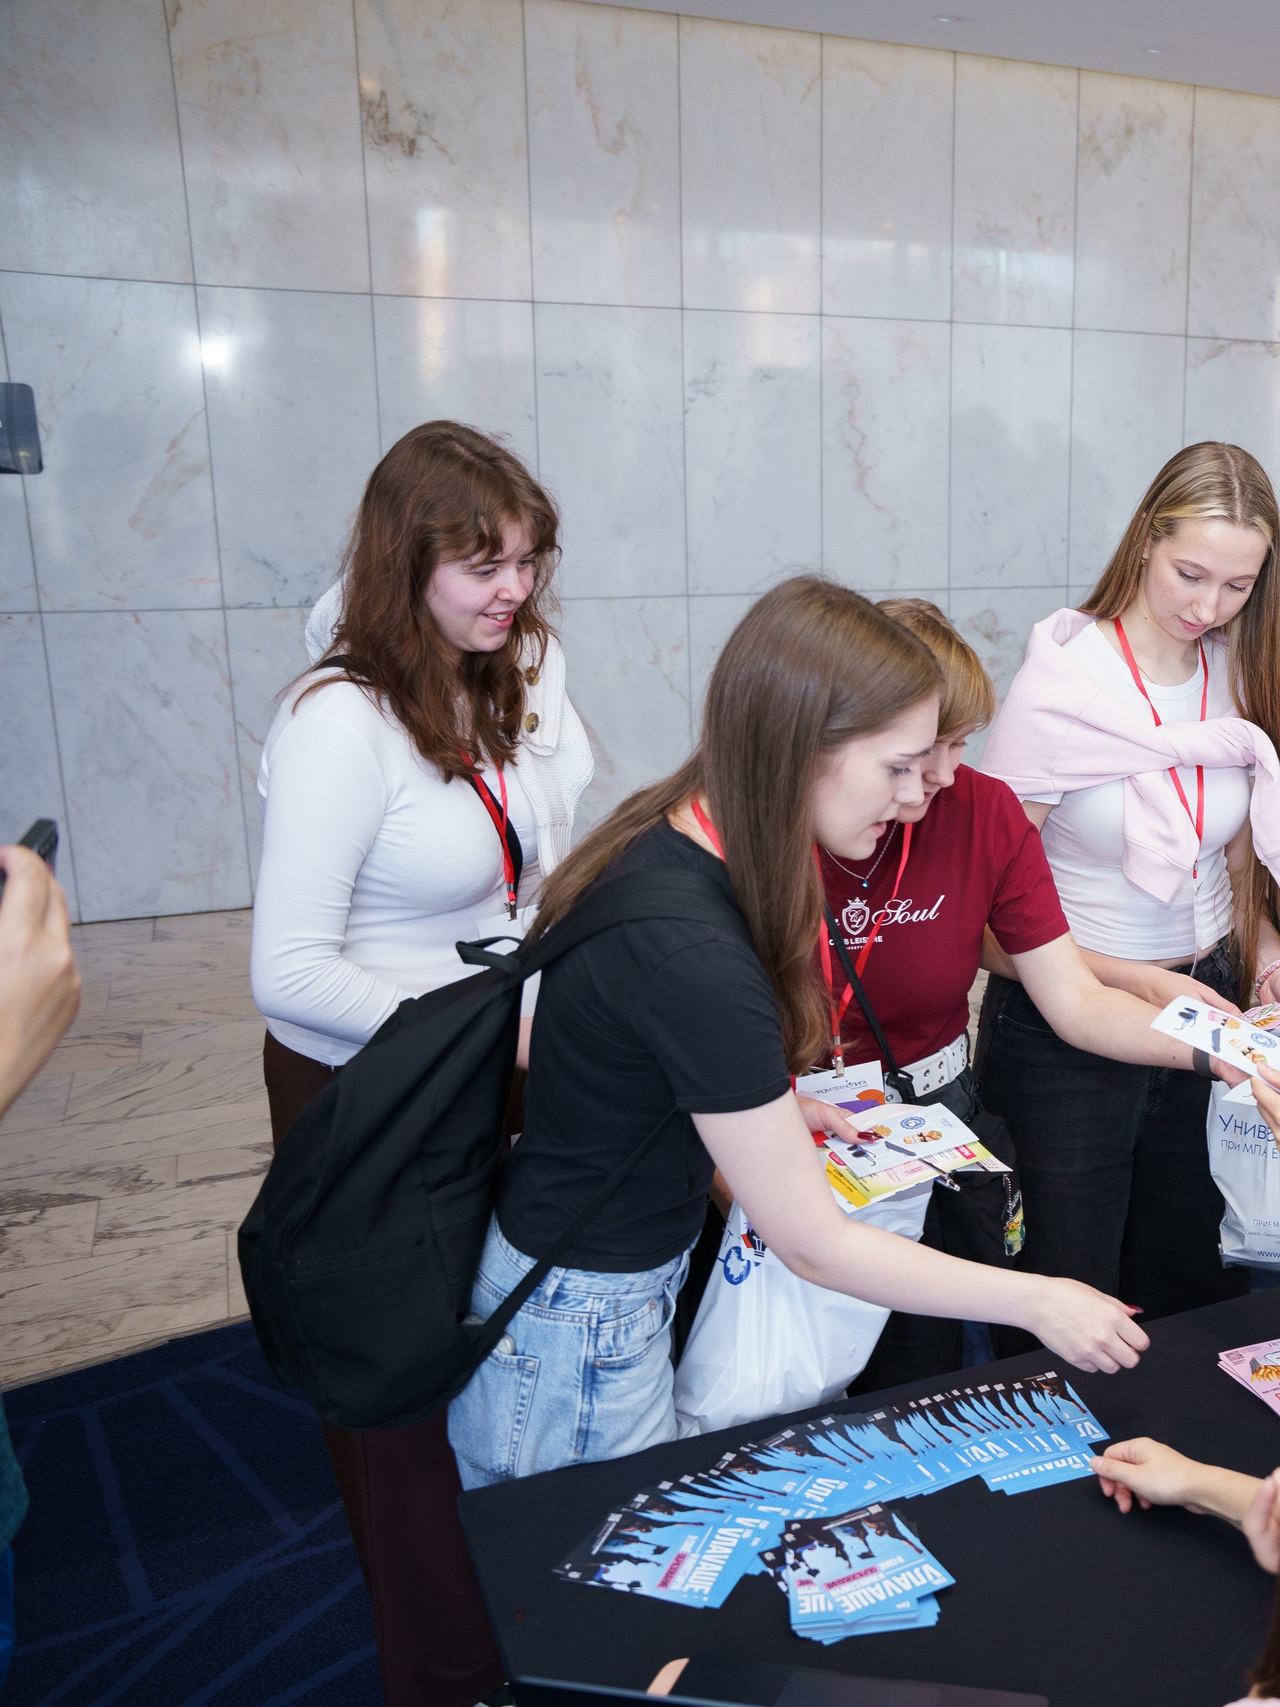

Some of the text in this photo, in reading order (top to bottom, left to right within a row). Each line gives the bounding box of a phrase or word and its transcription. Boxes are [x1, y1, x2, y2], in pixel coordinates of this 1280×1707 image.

[872, 895, 945, 926] Soul
[829, 936, 883, 946] CB LEISRE
[1221, 1139, 1240, 1151] при
[1242, 1143, 1268, 1158] МПА
[825, 1566, 879, 1589] ОБРАЗОВАНИЕ
